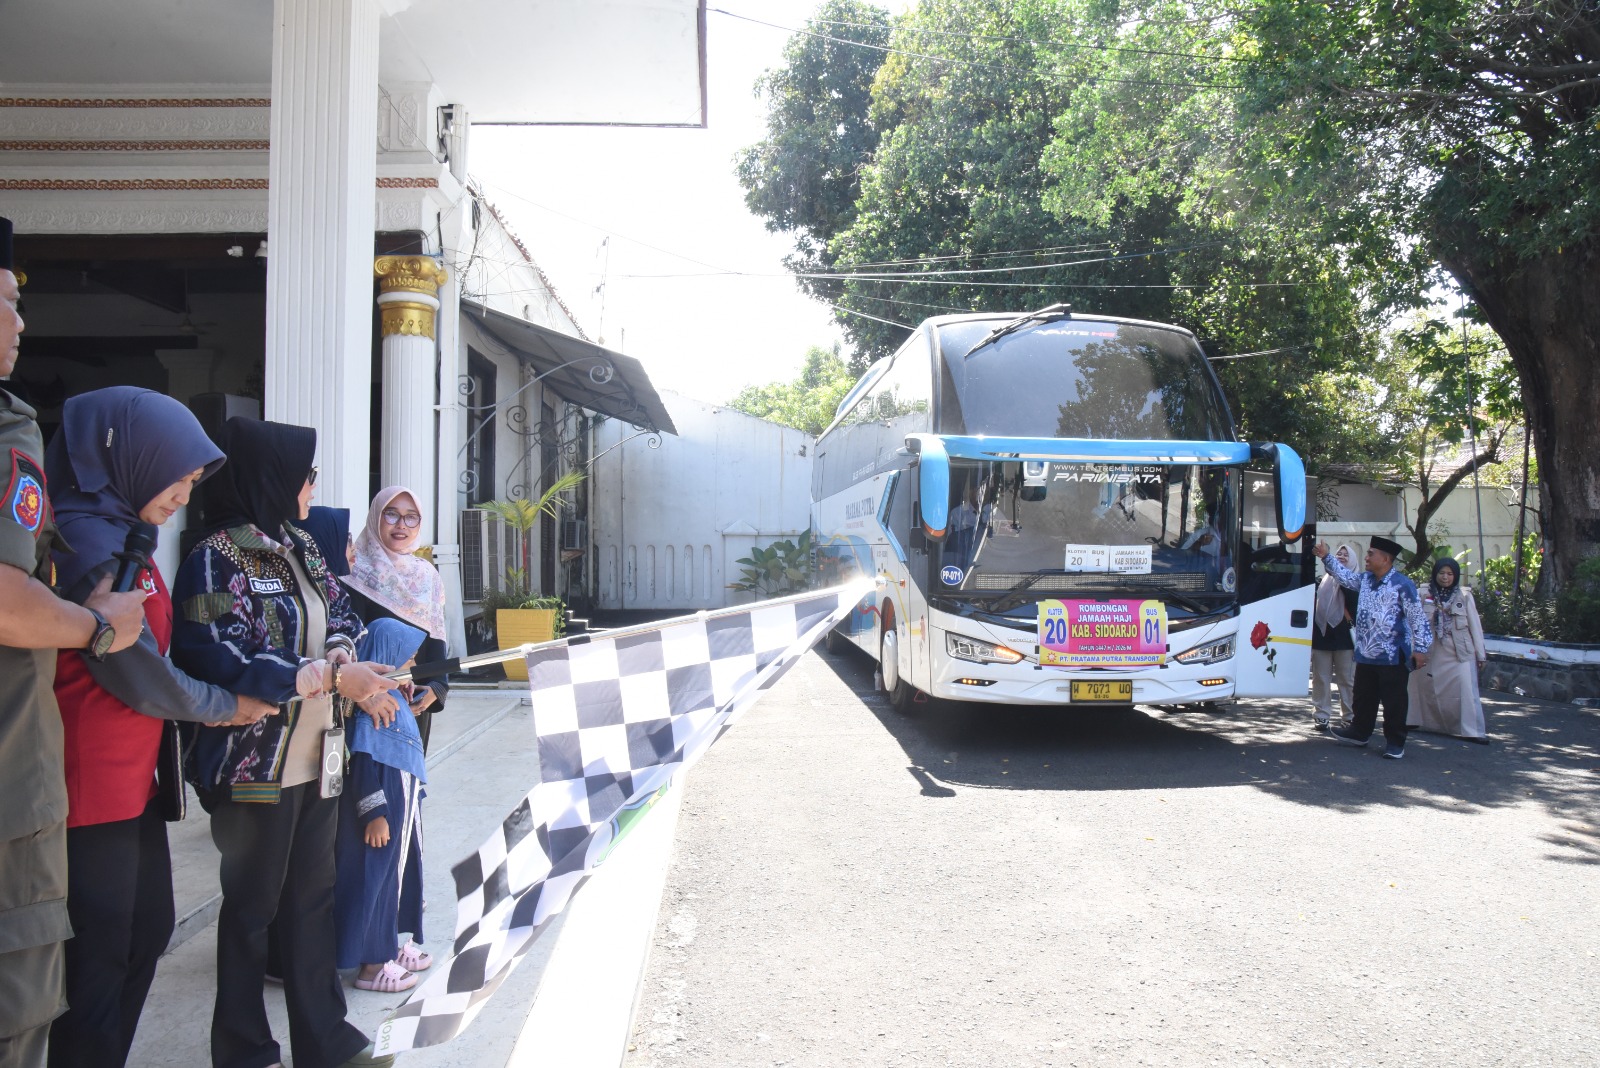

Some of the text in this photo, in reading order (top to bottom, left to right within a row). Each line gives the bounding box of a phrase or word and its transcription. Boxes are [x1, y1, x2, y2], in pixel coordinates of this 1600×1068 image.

[1053, 464, 1162, 472] WWW.TENTREMBUS.COM
[1053, 472, 1162, 484] PARIWISATA
[1070, 556, 1082, 566] 20
[1096, 558, 1100, 566] 1
[942, 570, 960, 580] PP-071
[1079, 604, 1128, 612] ROMBONGAN
[1078, 614, 1132, 622] JAMAAH HAJI
[1044, 618, 1066, 644] 20
[1071, 624, 1138, 638] KAB. SIDOARJO
[1144, 618, 1160, 644] 01
[1088, 684, 1110, 694] 7071
